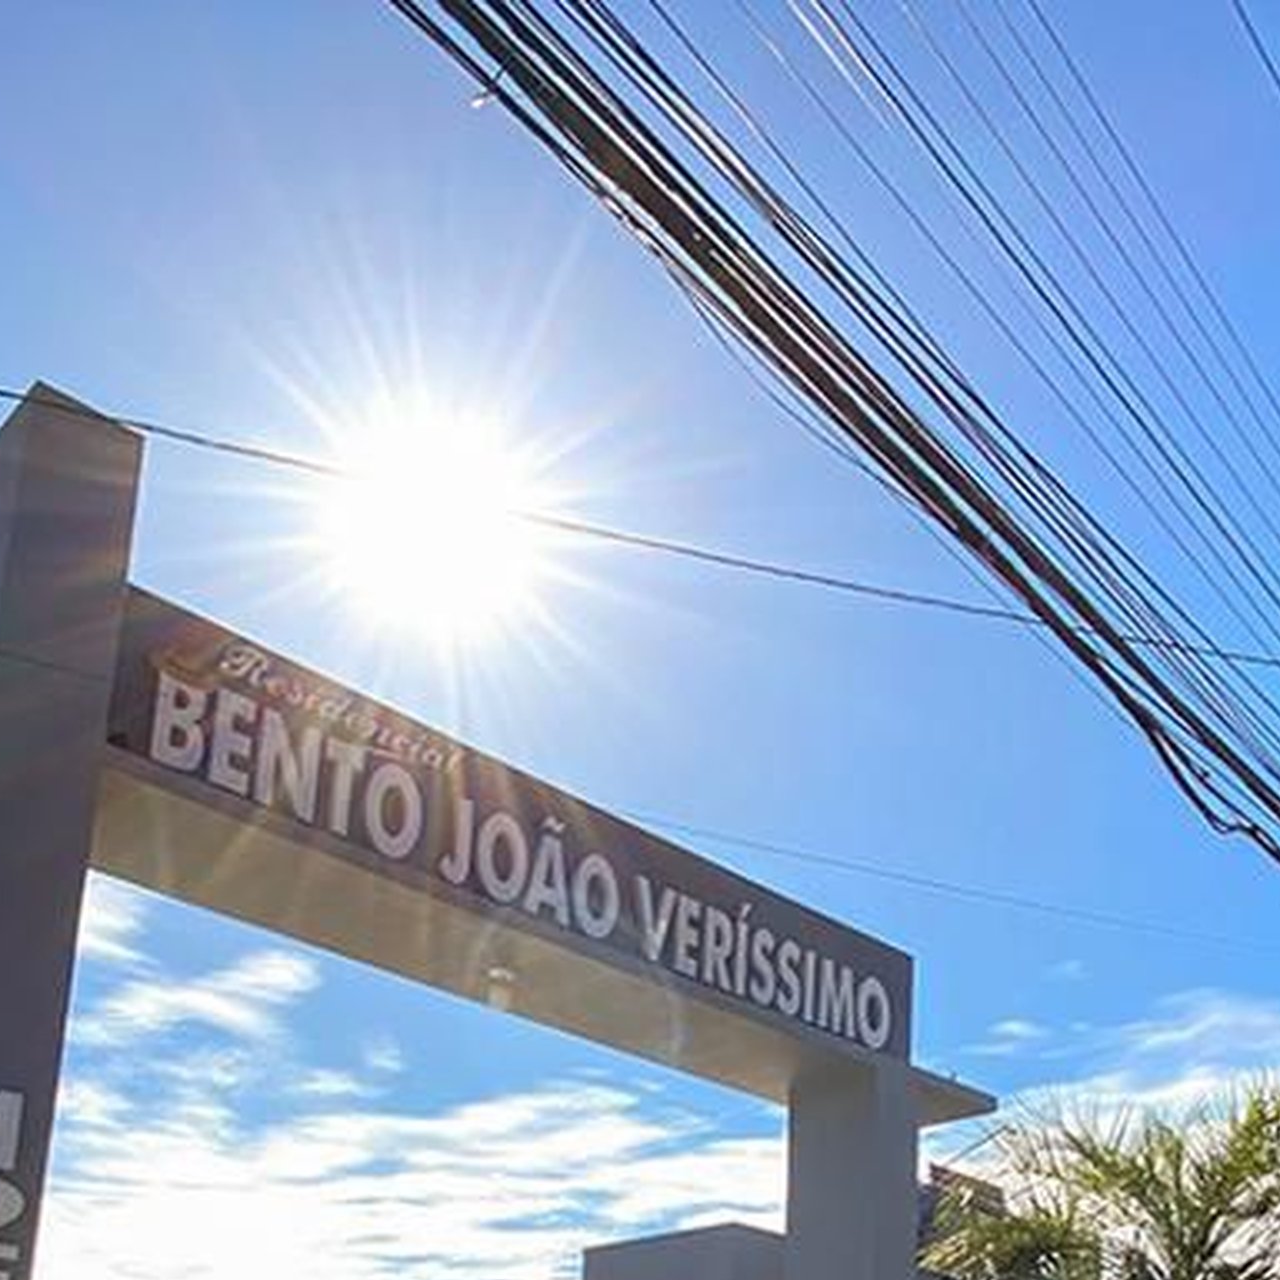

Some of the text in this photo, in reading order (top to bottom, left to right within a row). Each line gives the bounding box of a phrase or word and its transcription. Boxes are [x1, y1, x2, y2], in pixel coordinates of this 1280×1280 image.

[150, 674, 892, 1050] BENTO JOÃO VERÍSSIMO
